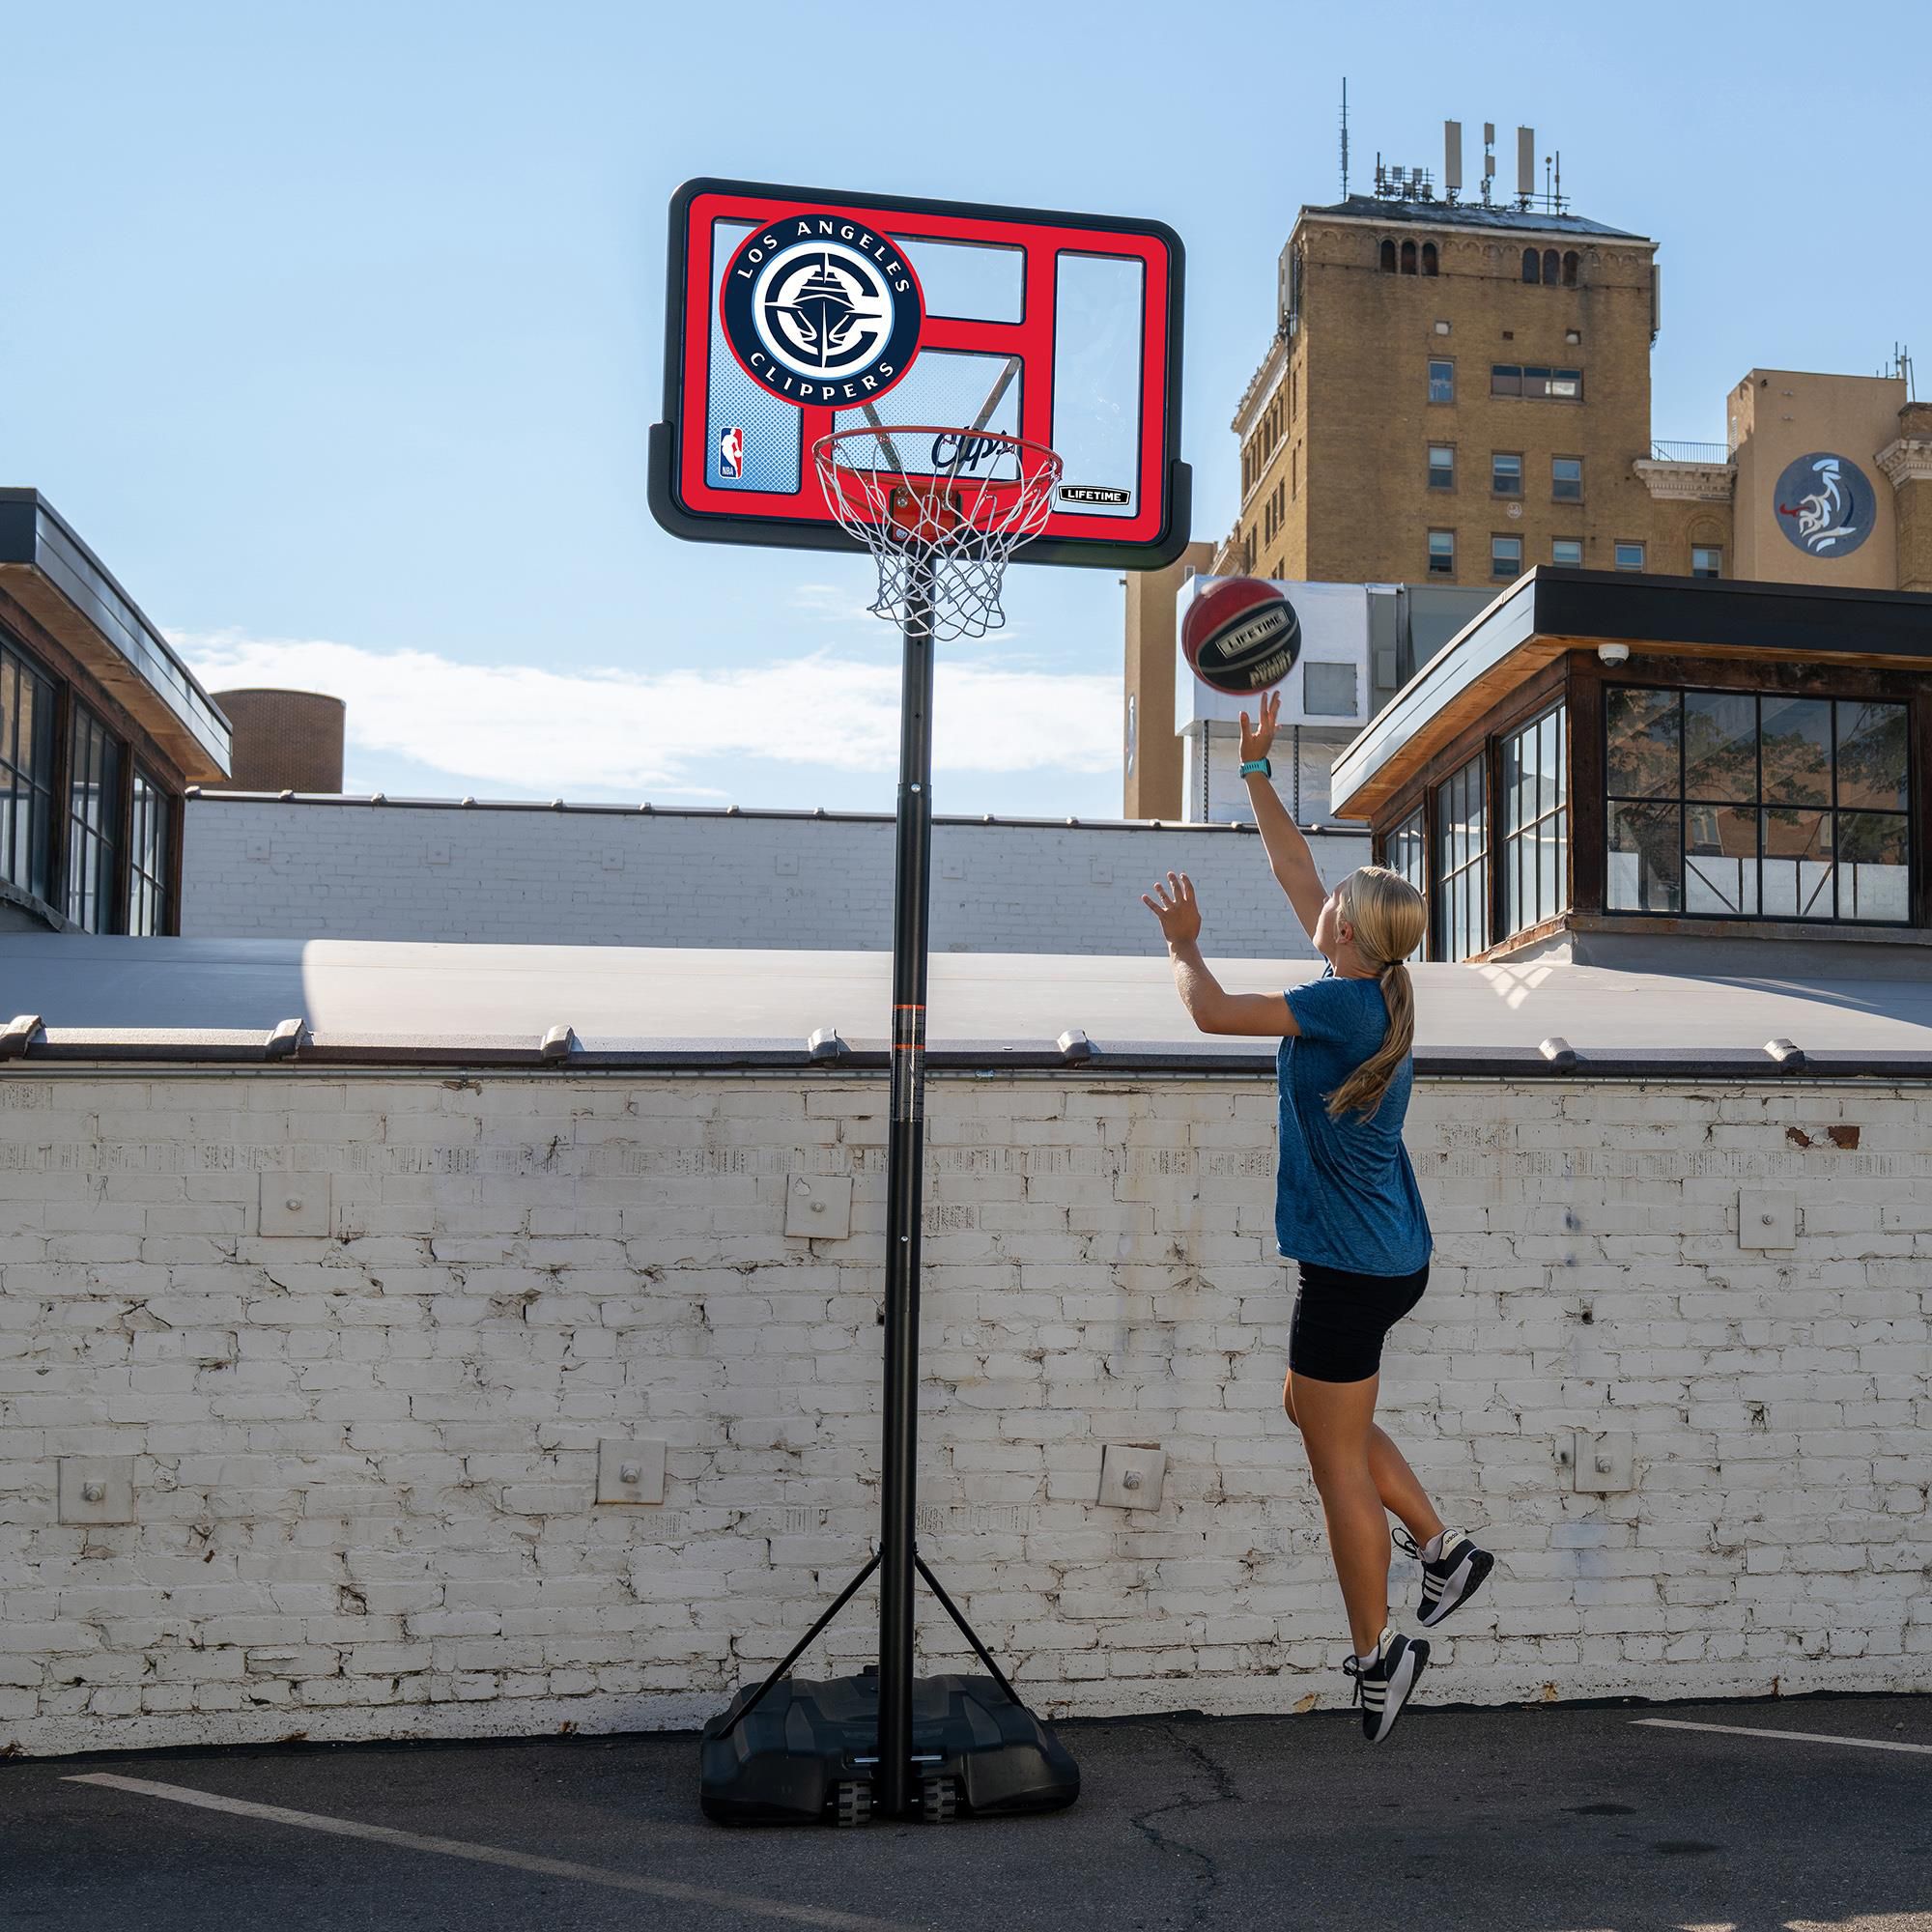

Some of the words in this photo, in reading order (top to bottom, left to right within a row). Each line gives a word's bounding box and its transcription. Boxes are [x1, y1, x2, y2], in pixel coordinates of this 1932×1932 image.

[738, 235, 778, 278] LOS
[797, 220, 910, 293] ANGELES
[750, 352, 894, 400] CLIPPERS
[722, 466, 734, 476] NBA
[1067, 489, 1122, 501] LIFETIME
[1227, 614, 1281, 650] LIFETIME
[1445, 1532, 1459, 1544] adida
